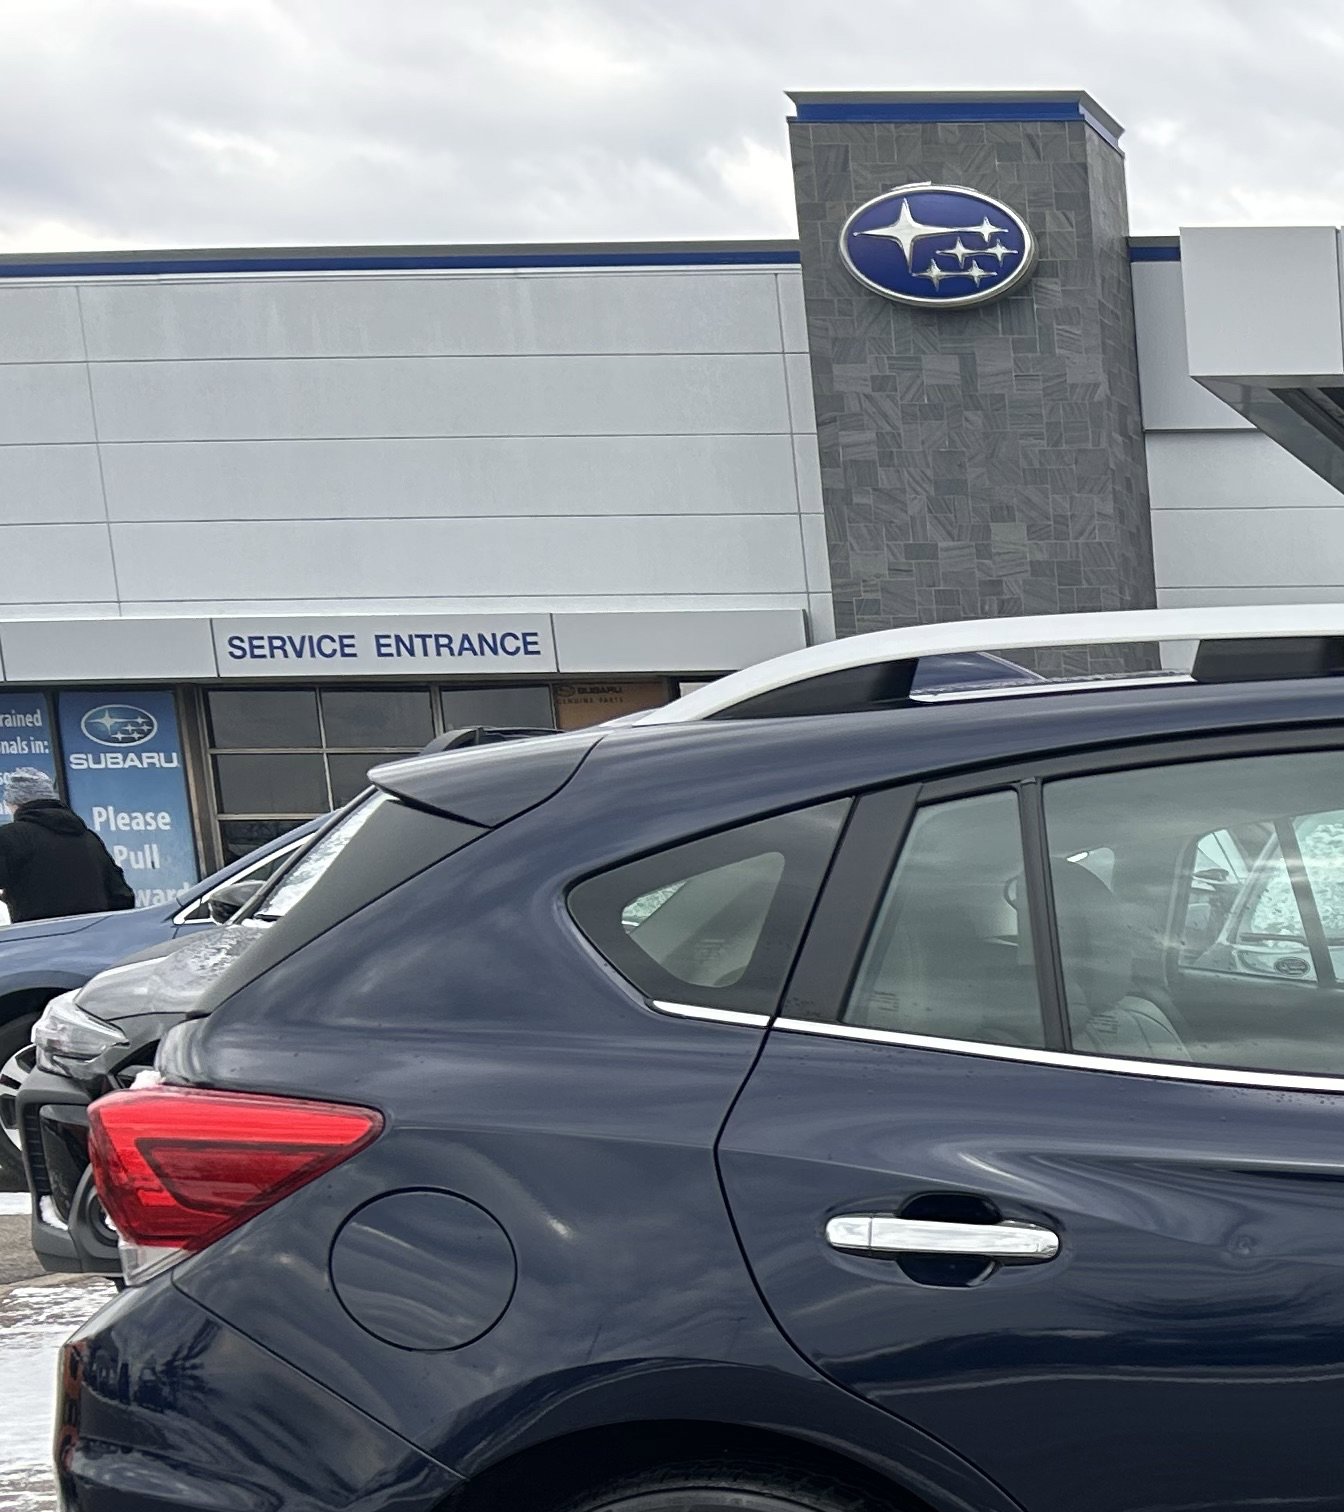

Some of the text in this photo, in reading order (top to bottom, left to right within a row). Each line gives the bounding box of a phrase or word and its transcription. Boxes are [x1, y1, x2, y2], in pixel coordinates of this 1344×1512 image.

[227, 631, 542, 660] SERVICE ENTRANCE
[30, 736, 49, 754] in:
[69, 752, 179, 769] SUBARU
[92, 806, 172, 831] Please
[113, 844, 161, 870] Pull
